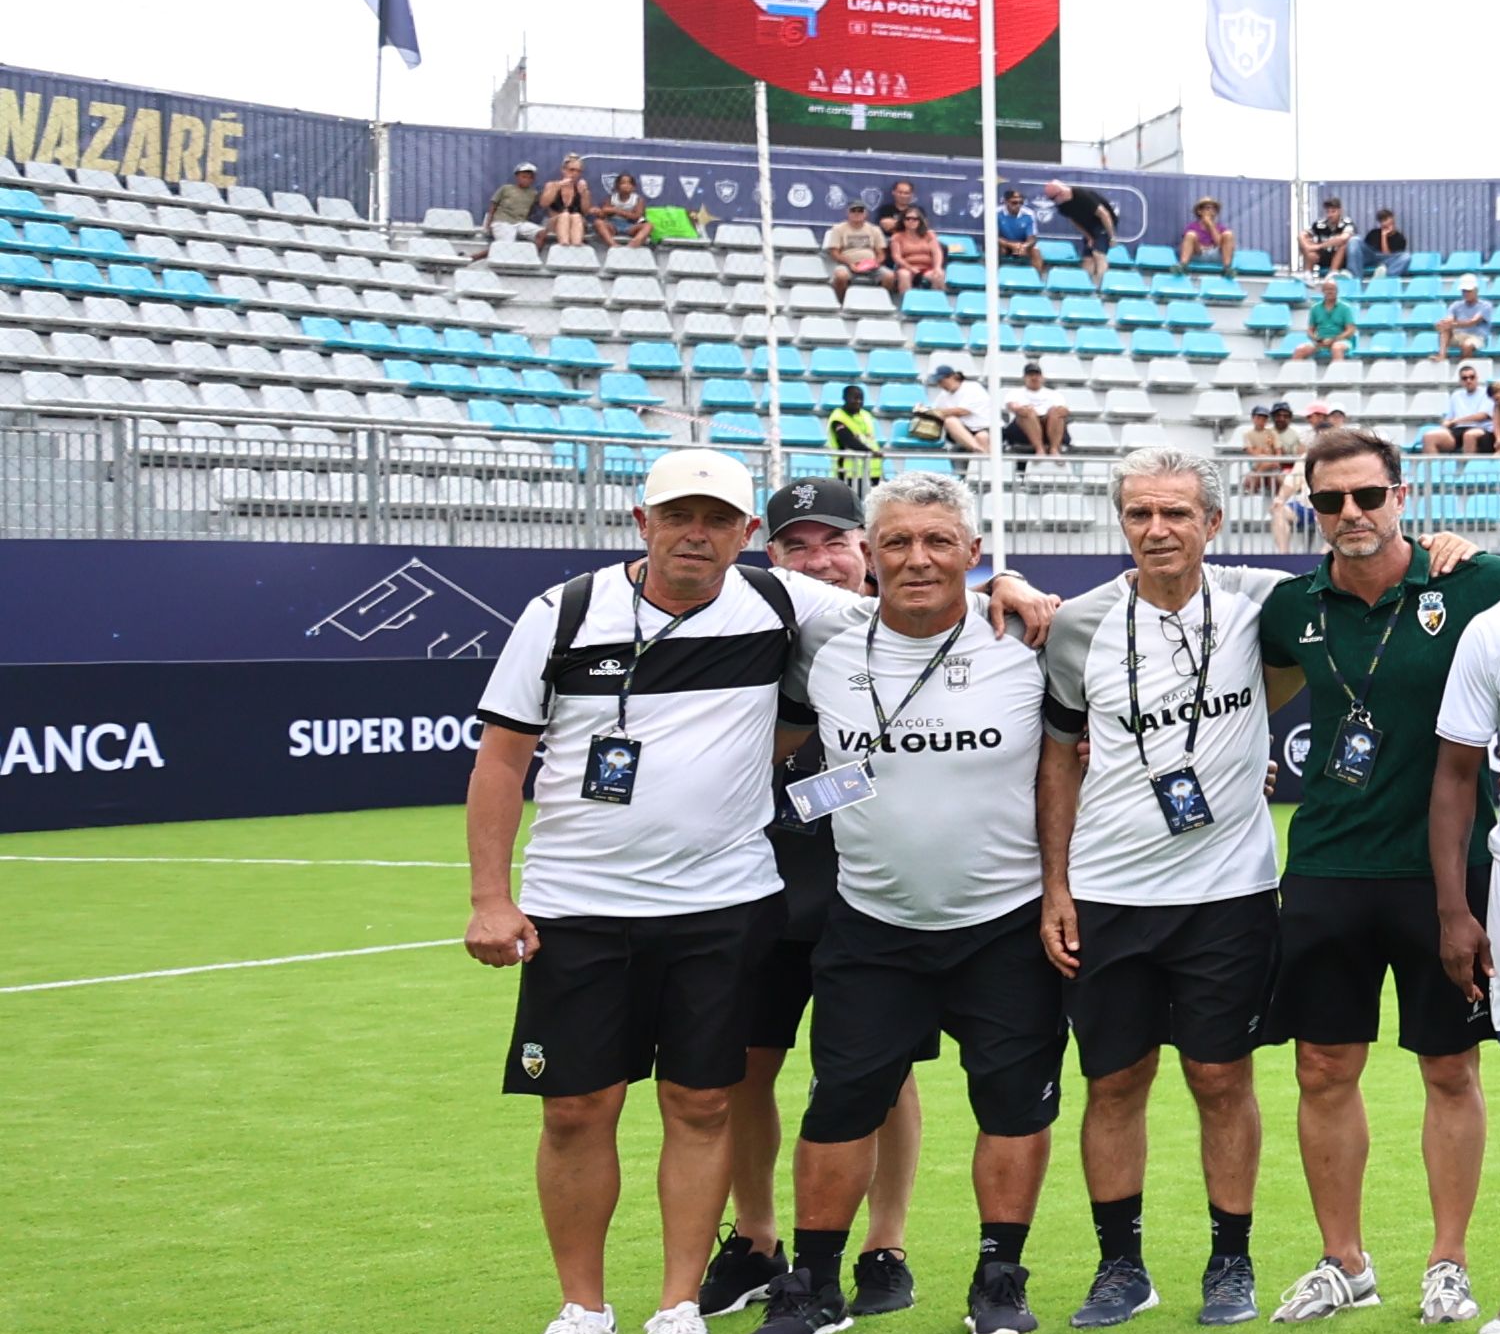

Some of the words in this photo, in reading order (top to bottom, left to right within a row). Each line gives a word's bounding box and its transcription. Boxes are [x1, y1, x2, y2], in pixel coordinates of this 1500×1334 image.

[886, 2, 973, 21] PORTUGAL
[0, 83, 243, 189] NAZARÉ
[1117, 687, 1252, 734] VALOURO
[0, 722, 164, 776] ANCA
[289, 719, 404, 757] SUPER
[410, 716, 483, 754] BOC
[838, 728, 1003, 754] VALOURO
